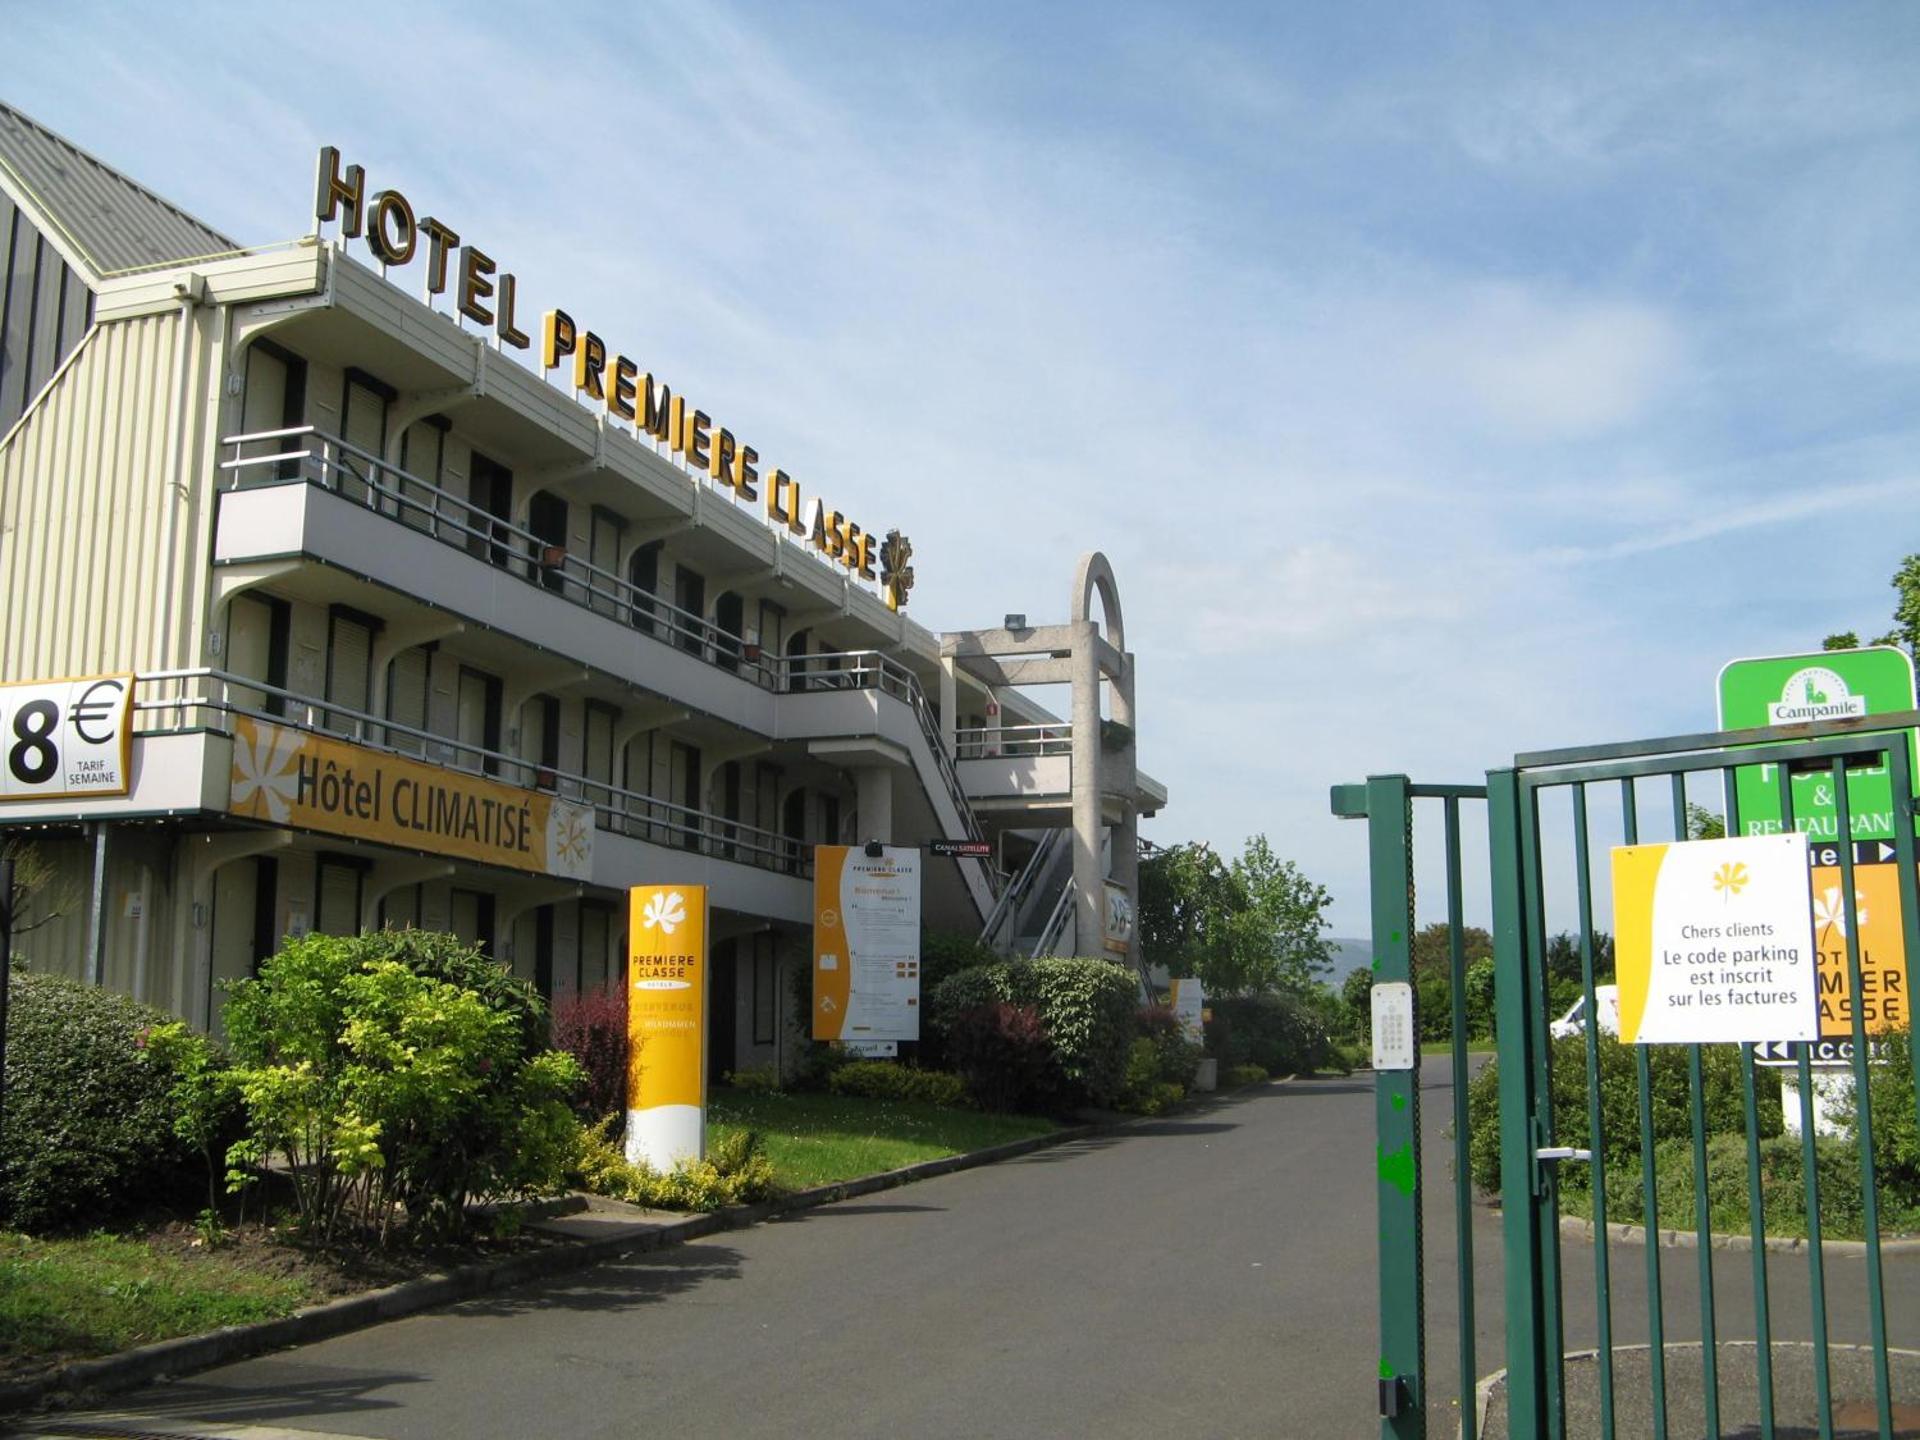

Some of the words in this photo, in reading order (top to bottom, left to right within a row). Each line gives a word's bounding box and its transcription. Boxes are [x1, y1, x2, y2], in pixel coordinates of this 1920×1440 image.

[316, 146, 530, 350] HOTEL
[543, 309, 759, 502] PREMIERE
[767, 469, 877, 581] CLASSE
[1776, 700, 1858, 720] Campanile
[77, 760, 105, 772] TARIF
[69, 772, 115, 785] SEMAINE
[297, 754, 382, 822] Hôtel
[392, 778, 531, 851] CLIMATISÉ
[1813, 784, 1833, 806] &
[1681, 925, 1721, 939] Chers
[1726, 922, 1774, 937] clients
[633, 955, 695, 966] PREMIERE
[1664, 950, 1682, 965] Le
[1687, 947, 1727, 964] code
[1733, 946, 1799, 966] parking
[639, 967, 685, 978] CLASSE
[1690, 969, 1715, 985] est
[1720, 967, 1773, 984] inscrit
[1668, 994, 1693, 1006] sur
[1699, 990, 1722, 1005] les
[1728, 988, 1798, 1005] factures
[1820, 997, 1900, 1021] ASSE
